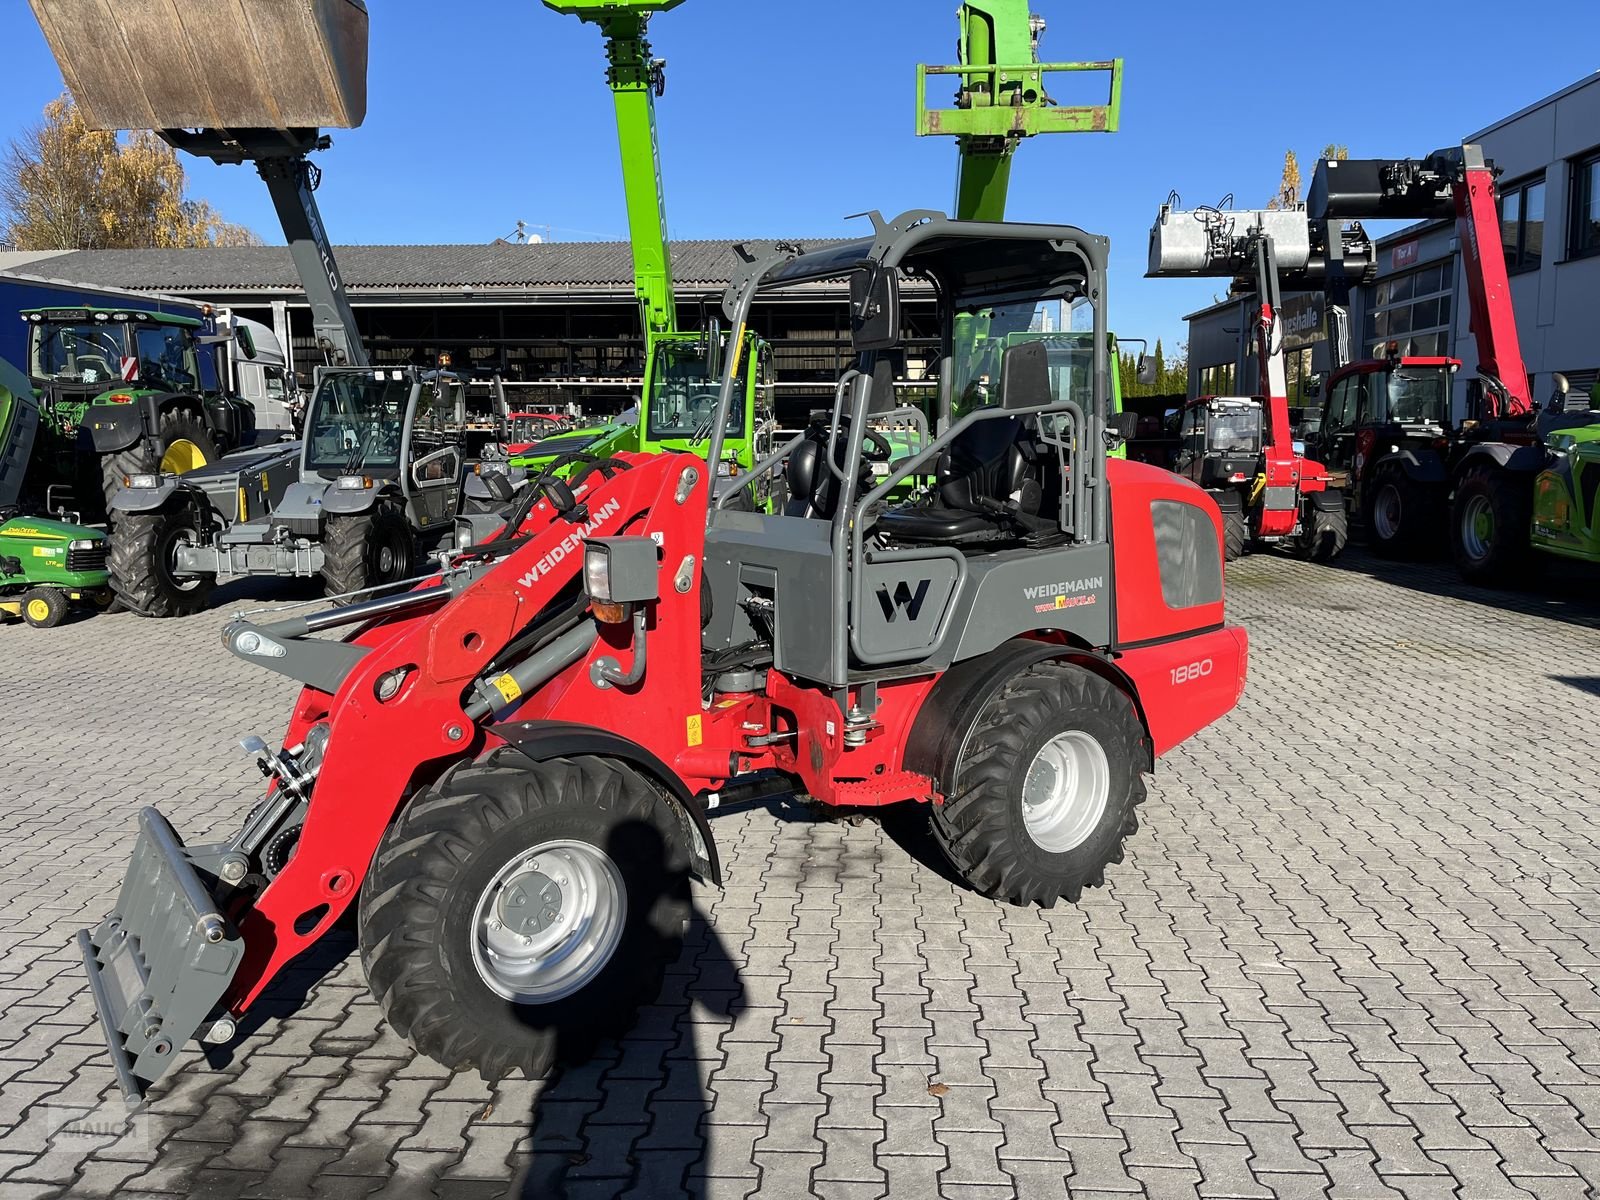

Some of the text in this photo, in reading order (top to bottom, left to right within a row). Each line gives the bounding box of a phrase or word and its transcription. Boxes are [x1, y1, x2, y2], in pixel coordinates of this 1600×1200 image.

[306, 203, 338, 291] MERLO
[1397, 248, 1406, 259] Tor
[517, 498, 621, 588] WEIDEMANN
[1023, 577, 1103, 600] WEIDEMANN
[1170, 658, 1213, 686] 1880
